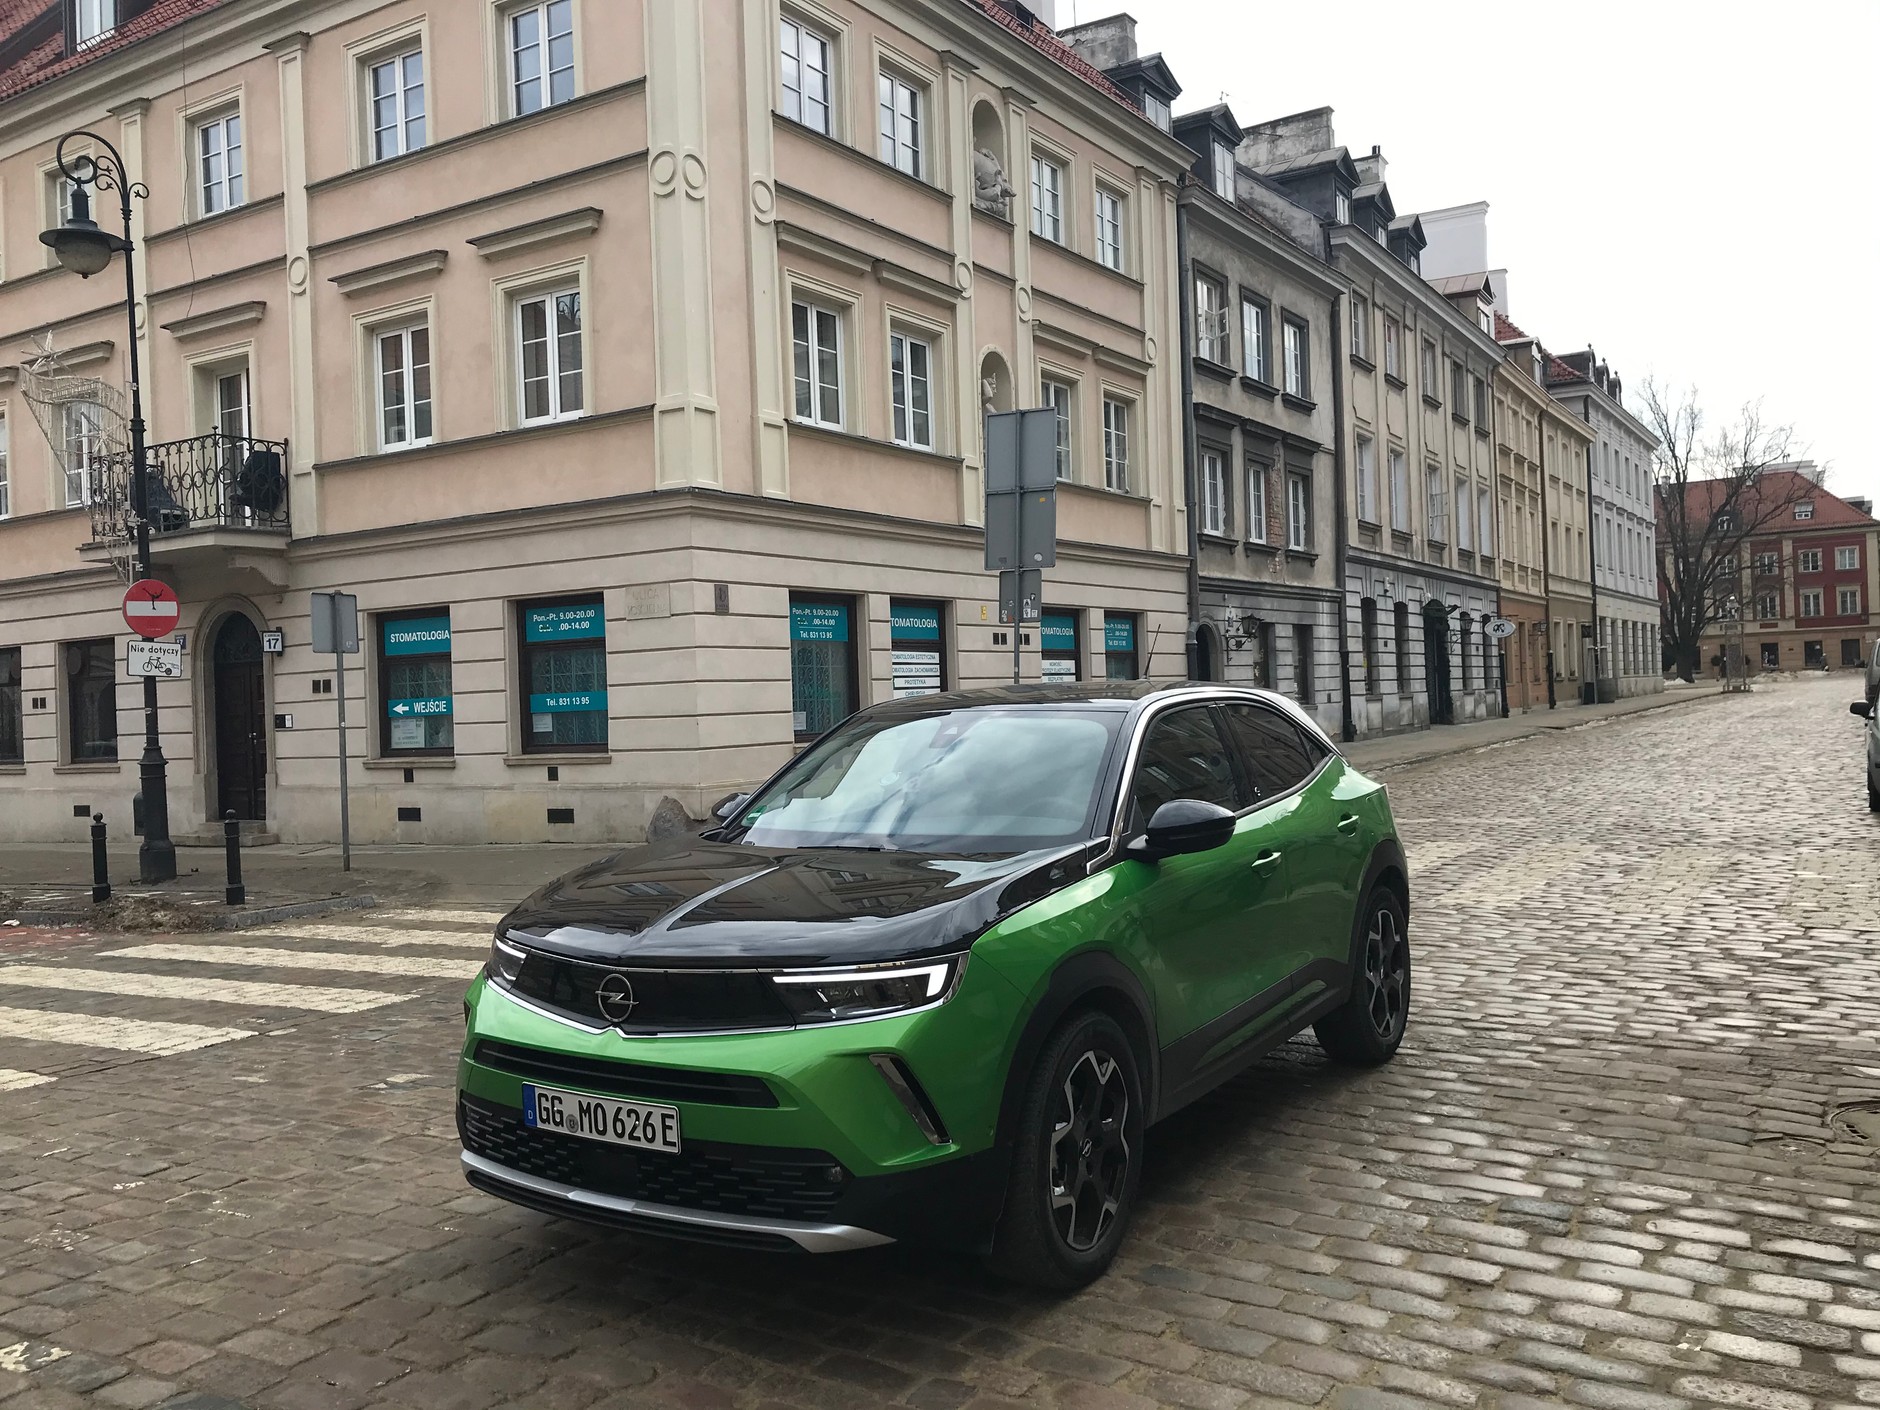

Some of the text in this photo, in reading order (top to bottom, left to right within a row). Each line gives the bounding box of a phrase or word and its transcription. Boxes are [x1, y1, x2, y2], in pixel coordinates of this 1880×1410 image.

[559, 609, 595, 620] 9.00-20.00
[891, 617, 938, 628] TOMATOLOGIA
[390, 629, 450, 643] STOMATOLOGIA
[810, 631, 818, 639] 831
[819, 631, 826, 639] 13
[826, 631, 833, 639] 95
[1041, 627, 1074, 636] OMATOLOGIA
[266, 637, 280, 650] 17
[130, 644, 179, 657] Nie dotyczy
[413, 699, 447, 713] WEJŚCIE
[546, 696, 590, 706] Tel. 831 13 95
[527, 1109, 534, 1120] D
[537, 1092, 564, 1128] GG
[578, 1099, 608, 1137] MO
